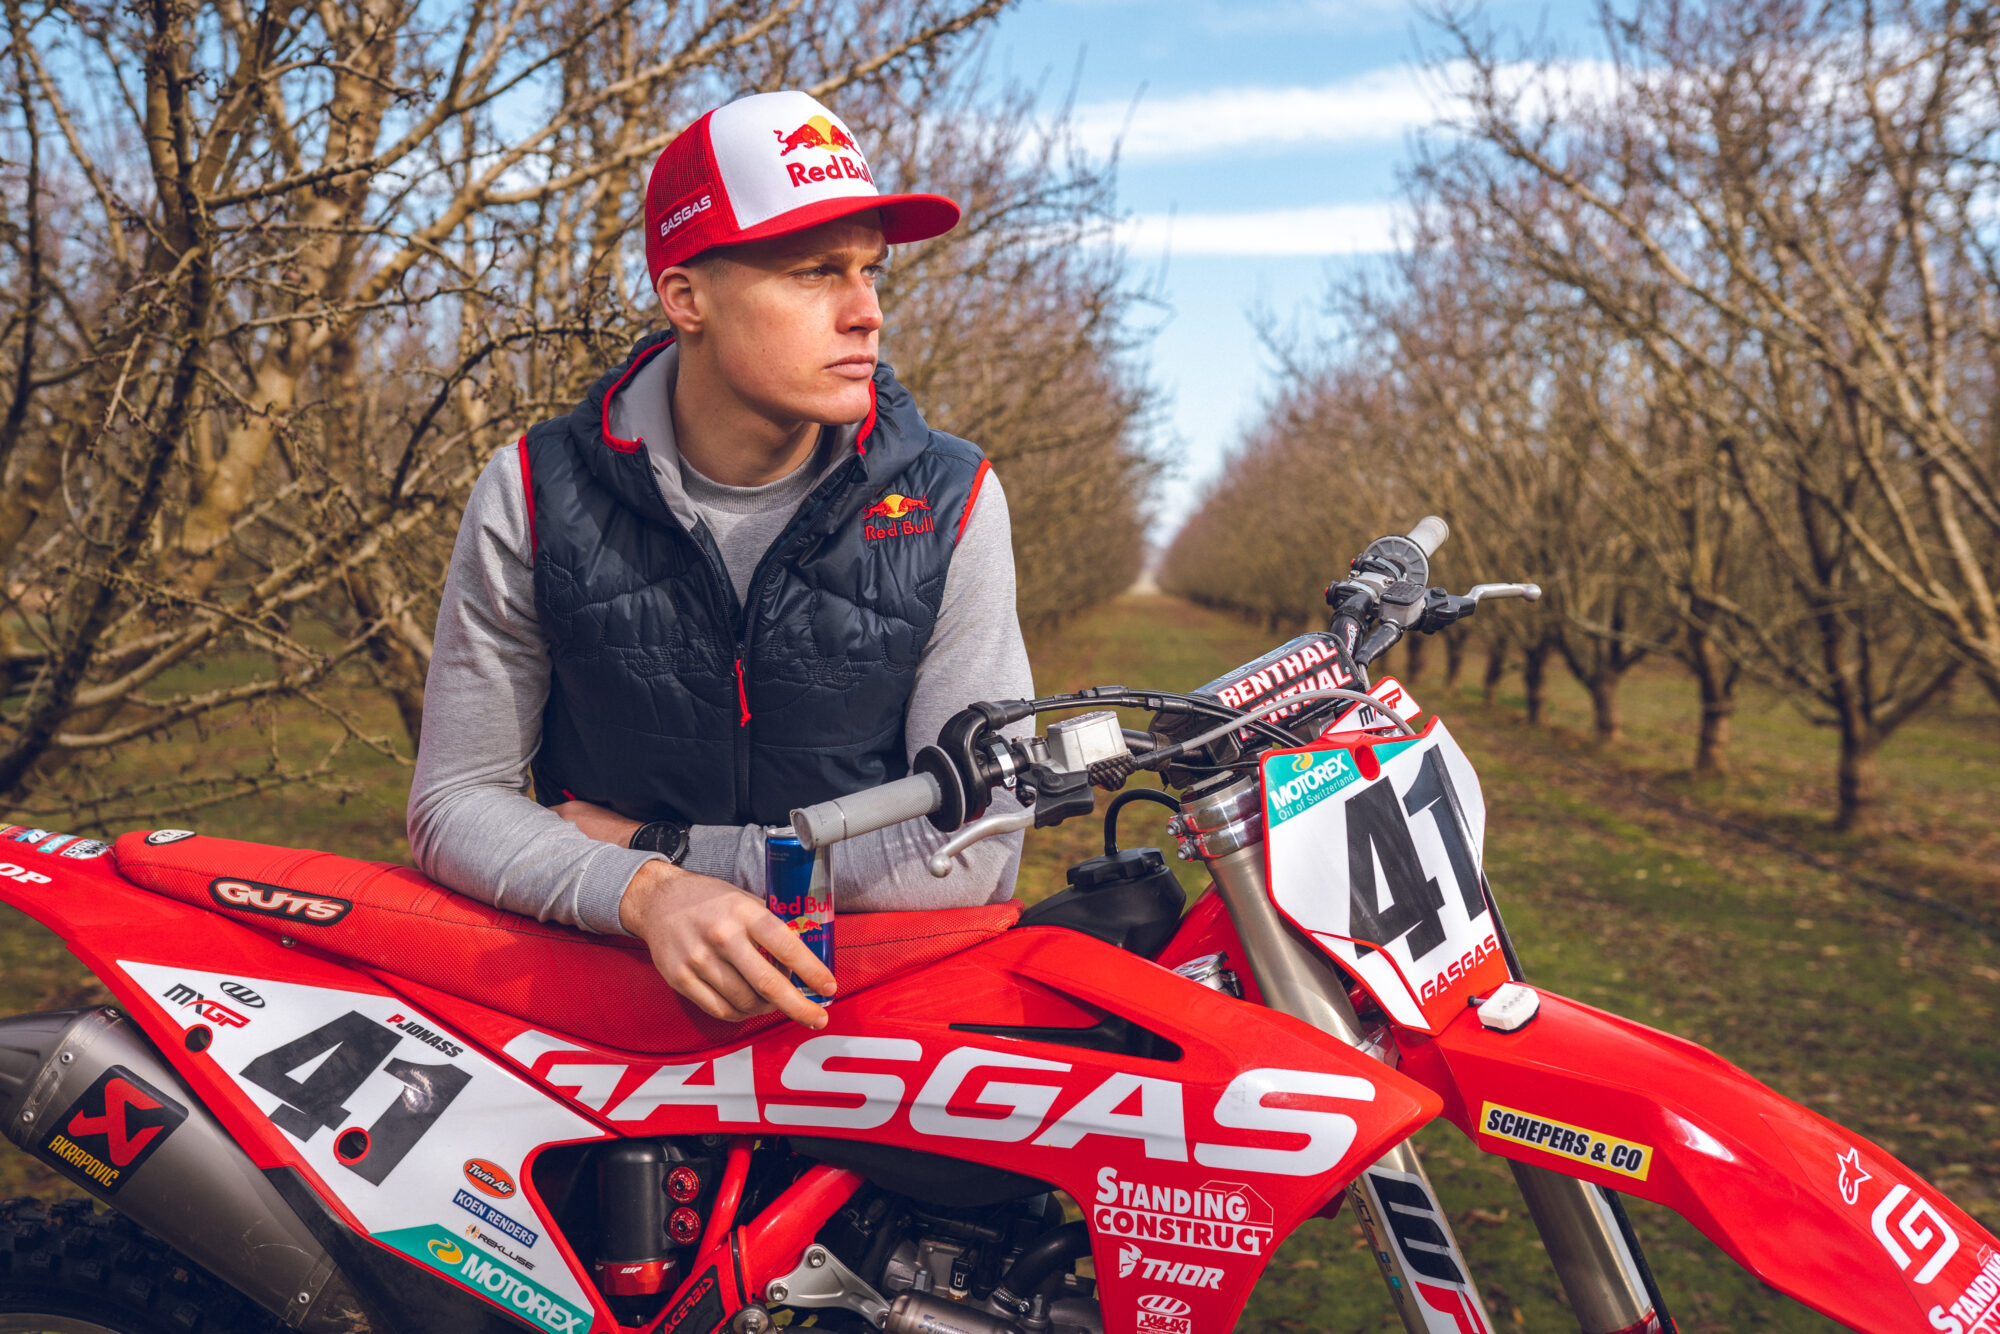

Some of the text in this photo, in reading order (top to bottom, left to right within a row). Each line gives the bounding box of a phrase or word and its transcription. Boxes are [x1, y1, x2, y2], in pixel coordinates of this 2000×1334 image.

[786, 154, 844, 187] Red
[660, 194, 712, 237] GASGAS
[864, 515, 934, 541] Red Bull
[1216, 640, 1339, 709] RENTHAL
[1269, 752, 1350, 811] MOTOREX
[1278, 770, 1355, 820] Oil of Switzerland
[1344, 743, 1488, 963] 41
[216, 881, 346, 921] GUTS
[769, 893, 833, 915] Red Bull
[1420, 934, 1501, 1006] GASGAS
[239, 1010, 473, 1187] 41
[500, 1029, 1377, 1177] GASGAS
[1487, 1108, 1643, 1173] SCHEPERS & CO
[468, 1163, 514, 1195] Twin Air
[1346, 1179, 1376, 1228] XACT
[456, 1191, 535, 1246] KOEN RENDERS
[1095, 1208, 1272, 1253] CONSTRUCT
[478, 1233, 536, 1271] REKLUSE
[1141, 1257, 1225, 1290] THOR
[461, 1253, 583, 1334] MOTOREX
